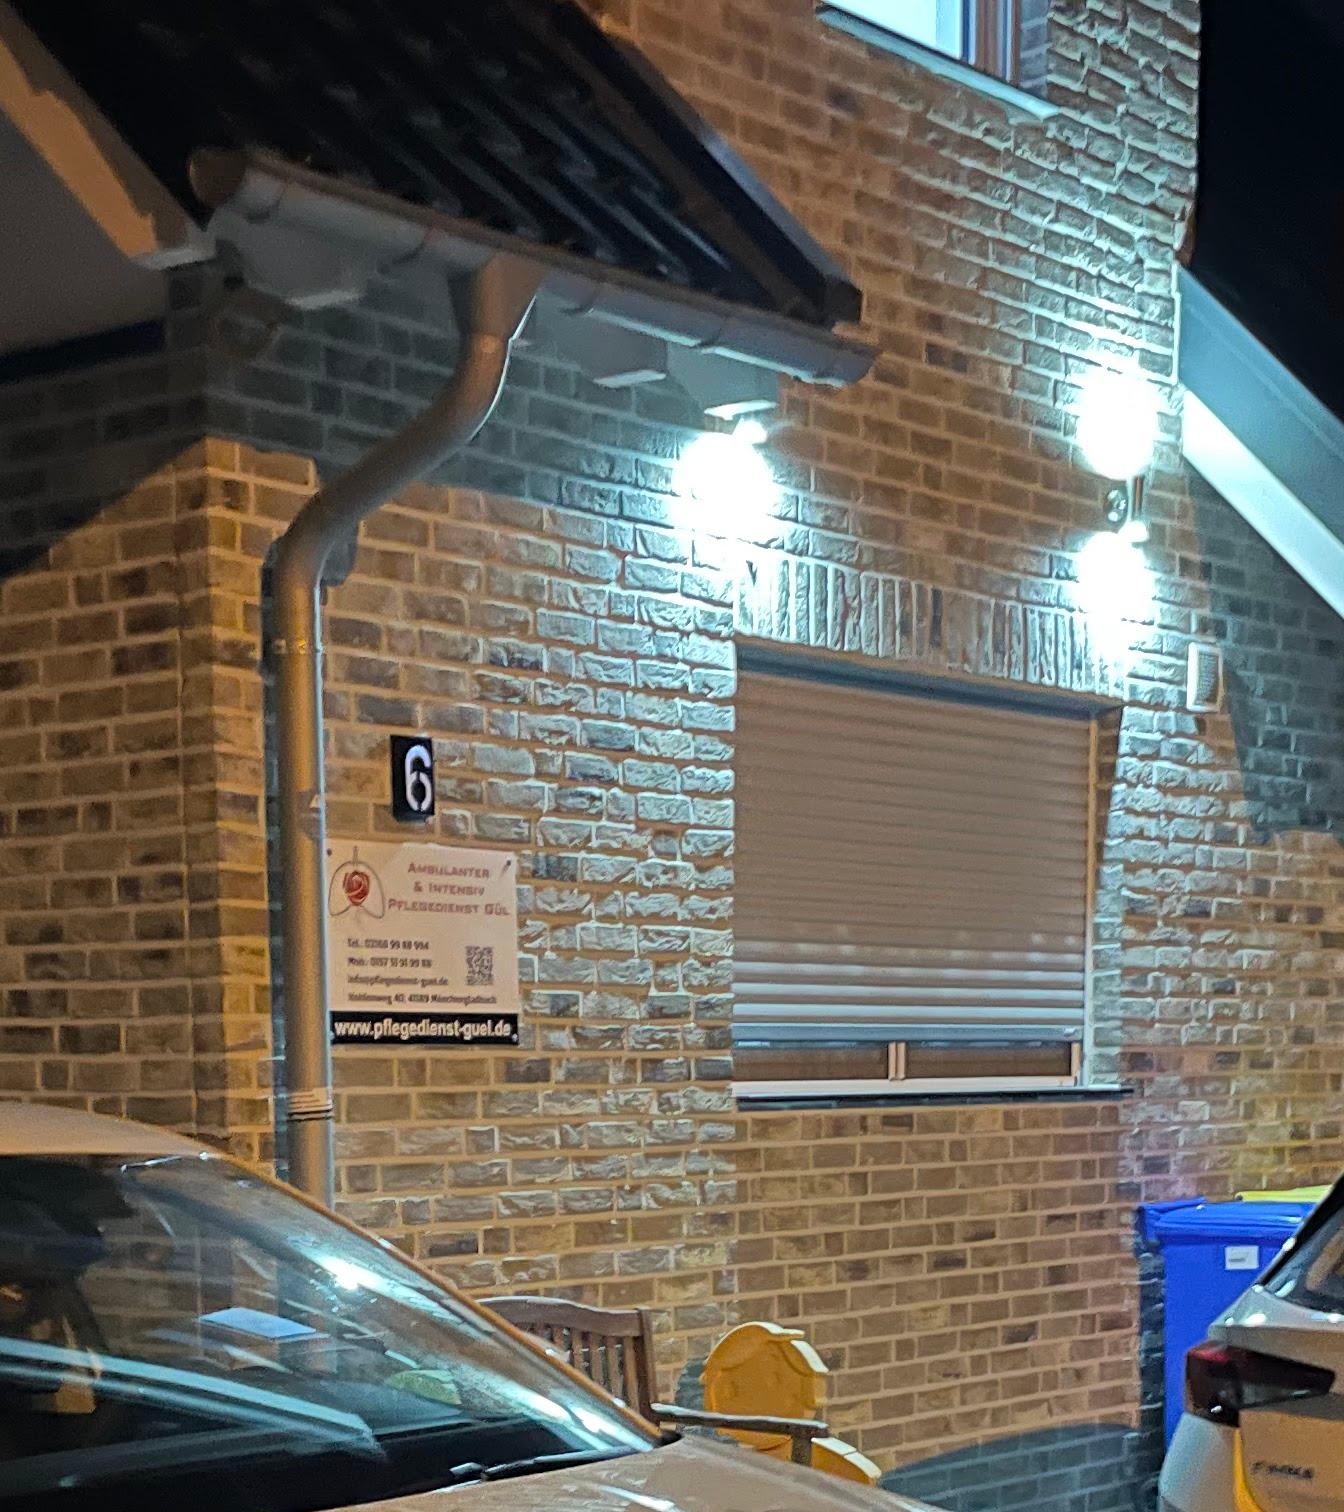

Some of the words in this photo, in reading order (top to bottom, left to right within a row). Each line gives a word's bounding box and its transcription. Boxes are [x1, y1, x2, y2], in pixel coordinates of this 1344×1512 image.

[404, 743, 432, 813] 6
[407, 862, 490, 879] AMBULANTER
[413, 881, 423, 893] &
[429, 883, 486, 897] INTENSIV
[387, 898, 478, 915] PFLEGEDIENST
[333, 1018, 512, 1040] www.pflegedienst-guel.de
